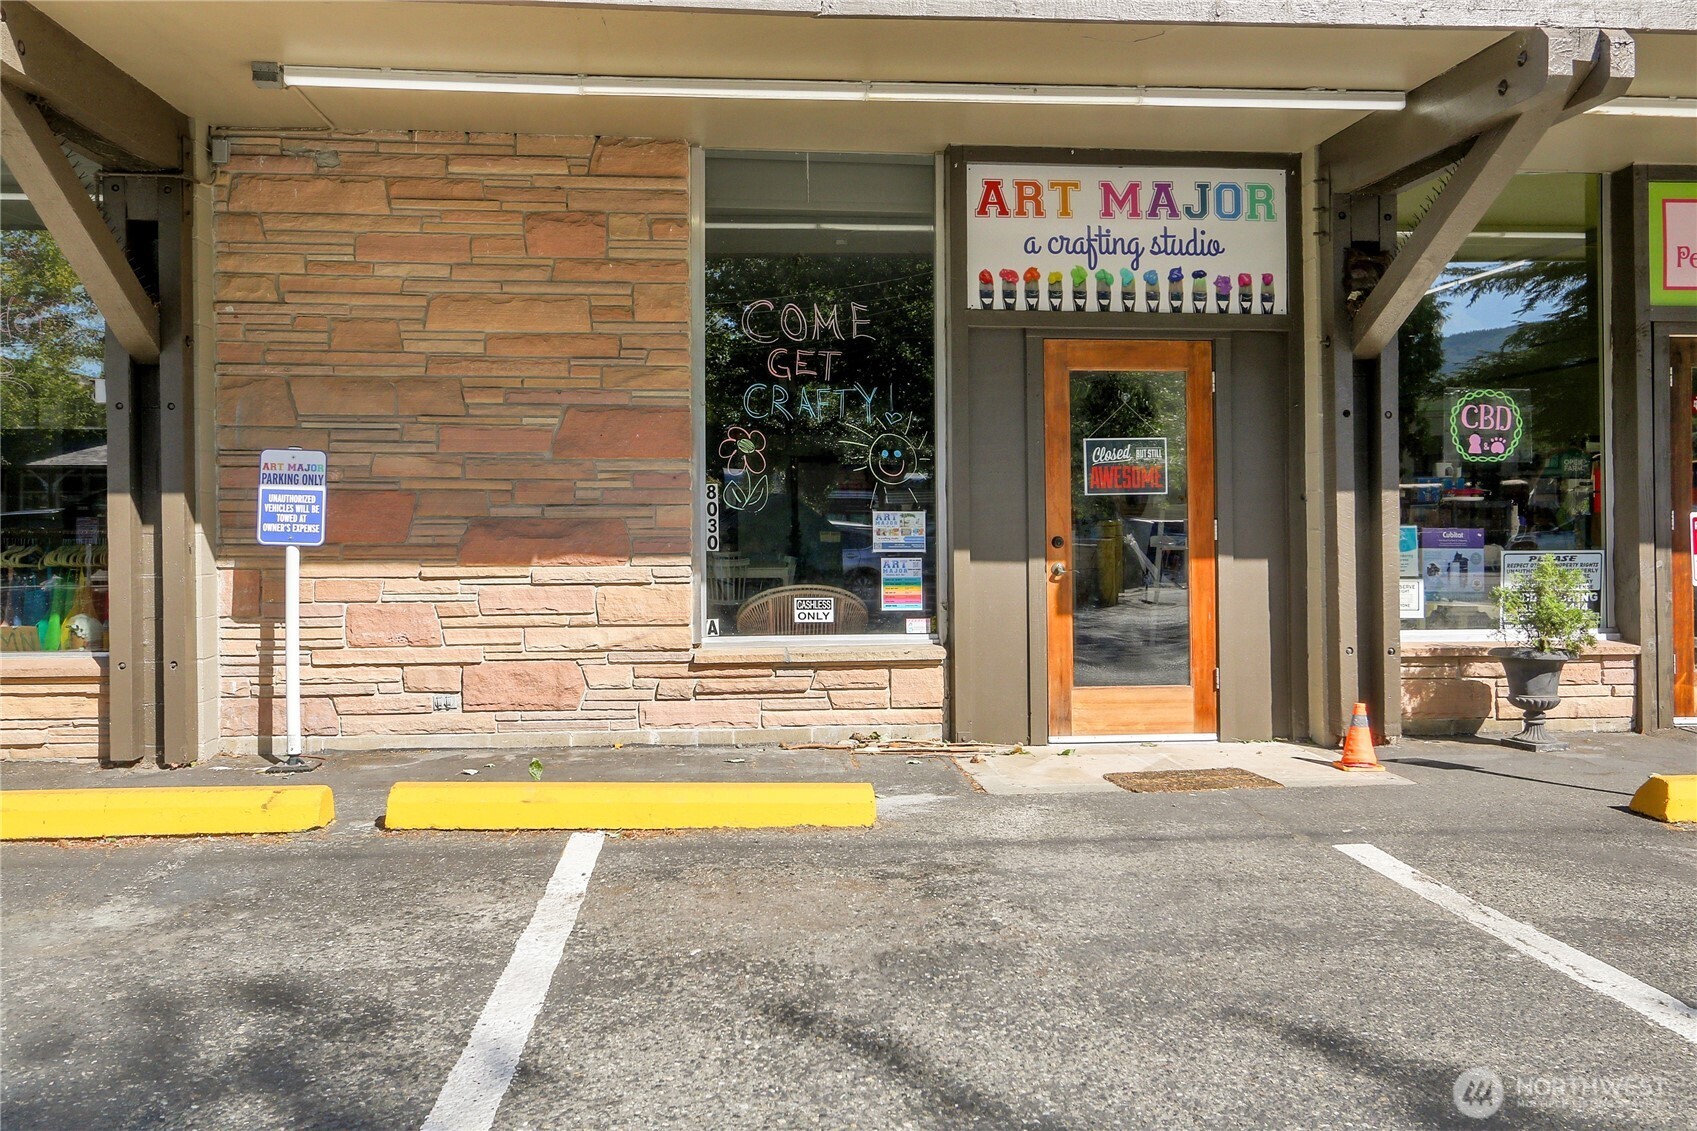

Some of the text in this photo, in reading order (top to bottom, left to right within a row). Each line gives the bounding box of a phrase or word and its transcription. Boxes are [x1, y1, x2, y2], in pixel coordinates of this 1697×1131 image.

[975, 178, 1278, 222] ART MAJOR
[1024, 225, 1225, 270] a crafting studio
[741, 300, 876, 343] COME
[767, 348, 843, 381] GET
[1461, 404, 1512, 431] CBD
[1092, 444, 1132, 463] Closed
[288, 464, 324, 472] MAJOR
[262, 472, 324, 486] PARKING ONLY
[1090, 465, 1164, 489] AWESOME
[268, 494, 316, 504] UNAUTHORIZED
[264, 504, 320, 513] VEHICLES WILL BE
[276, 514, 307, 523] TOWED AT
[706, 485, 718, 550] 8030
[262, 523, 320, 533] OWNER'S EXPENSE
[883, 560, 907, 568] ART
[797, 600, 831, 609] CASHLESS
[797, 612, 830, 620] ONLY
[707, 620, 718, 635] A
